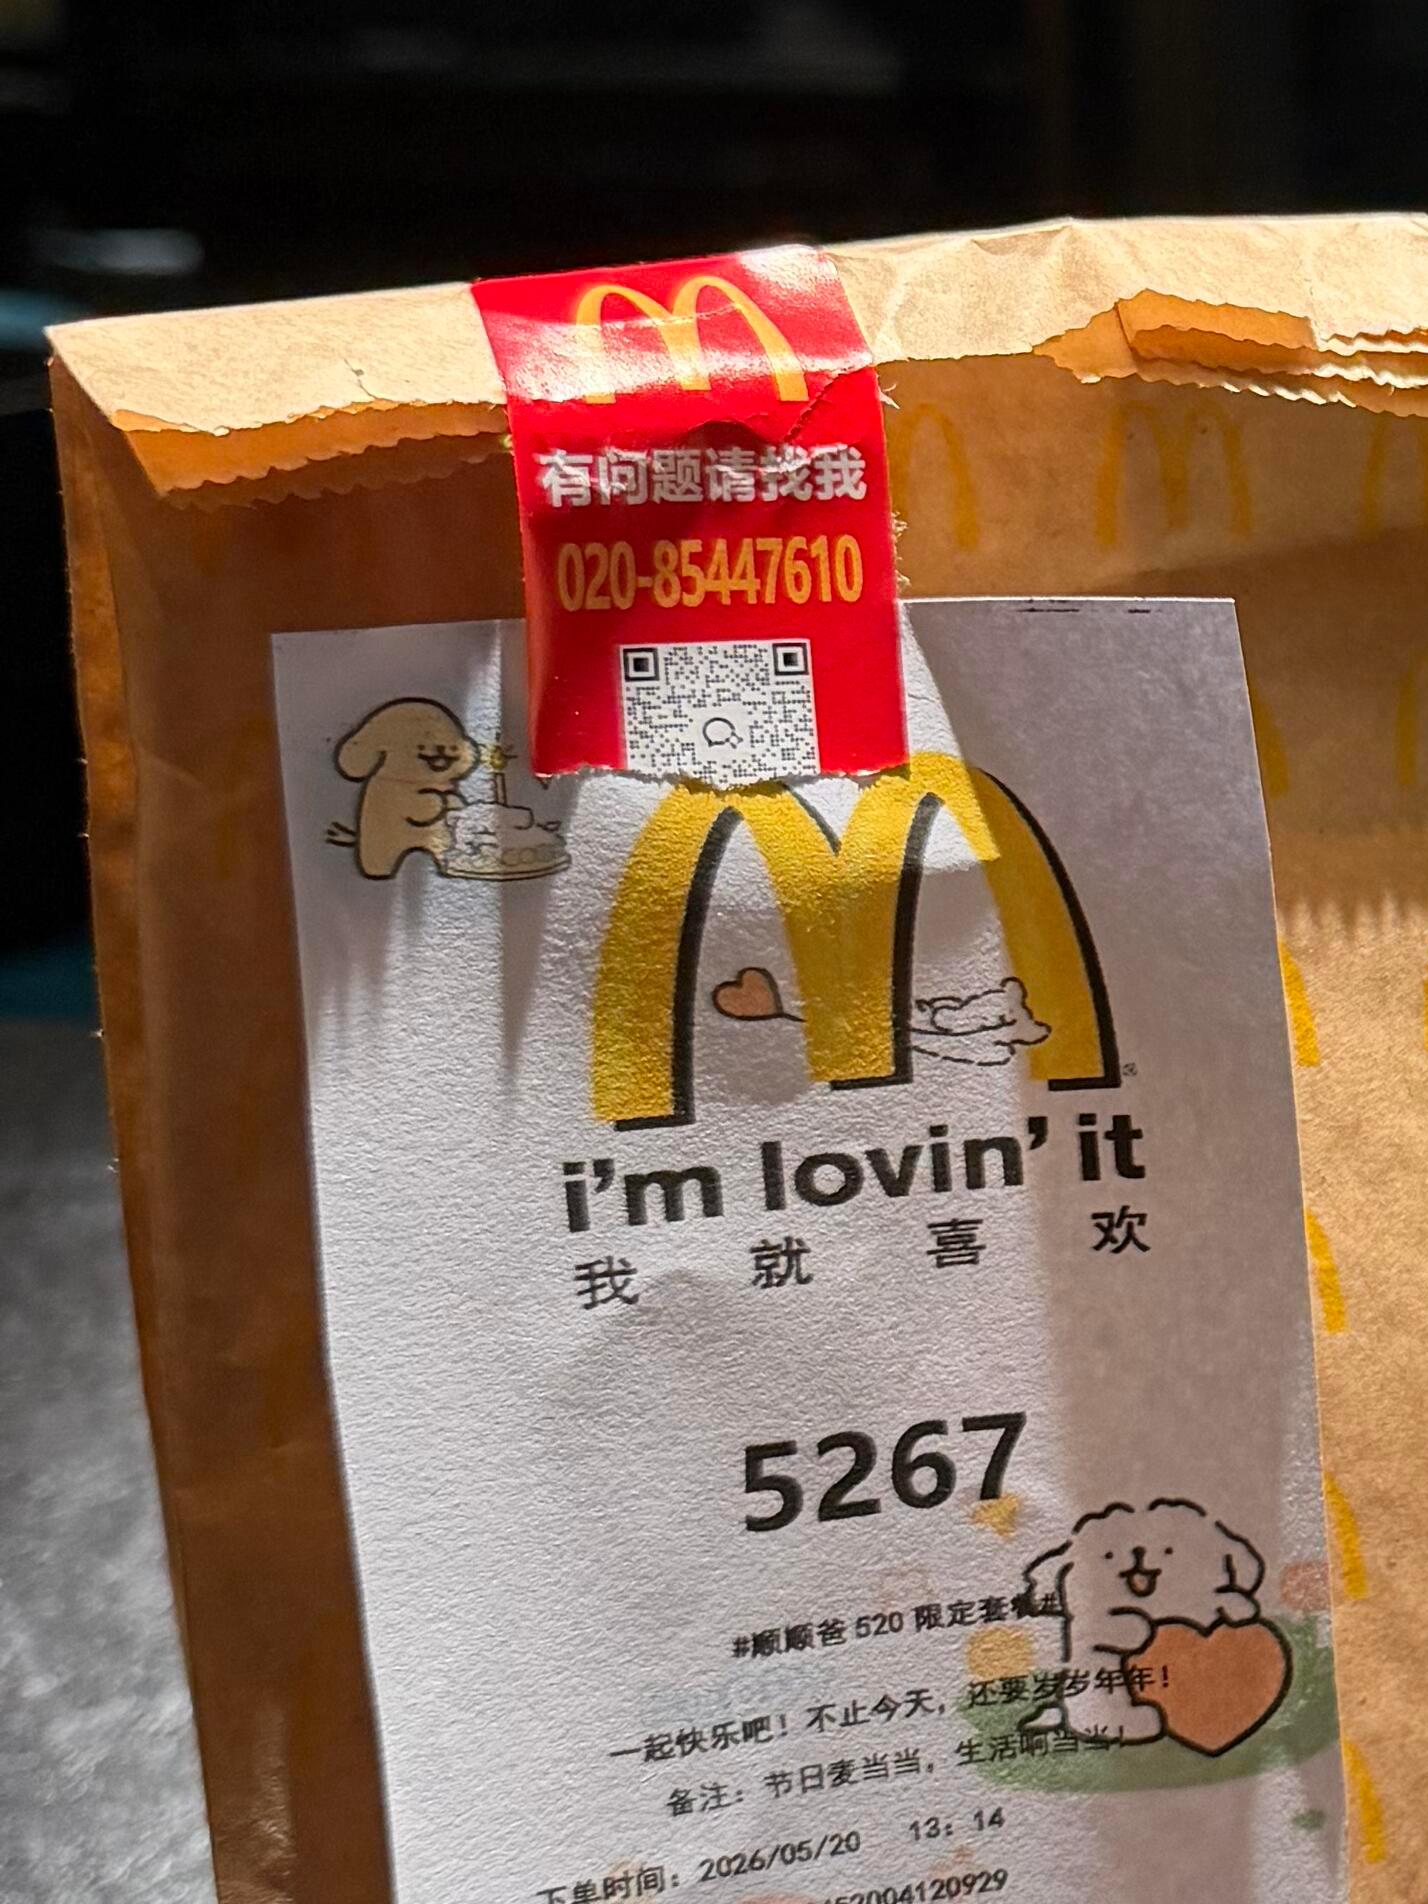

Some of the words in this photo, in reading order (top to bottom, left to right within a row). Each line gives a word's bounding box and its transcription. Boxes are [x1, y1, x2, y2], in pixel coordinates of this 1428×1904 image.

[535, 444, 868, 508] 有问题请找我
[557, 534, 864, 612] 020-85447610
[1076, 1113, 1146, 1182] it
[743, 1410, 1028, 1533] 5267
